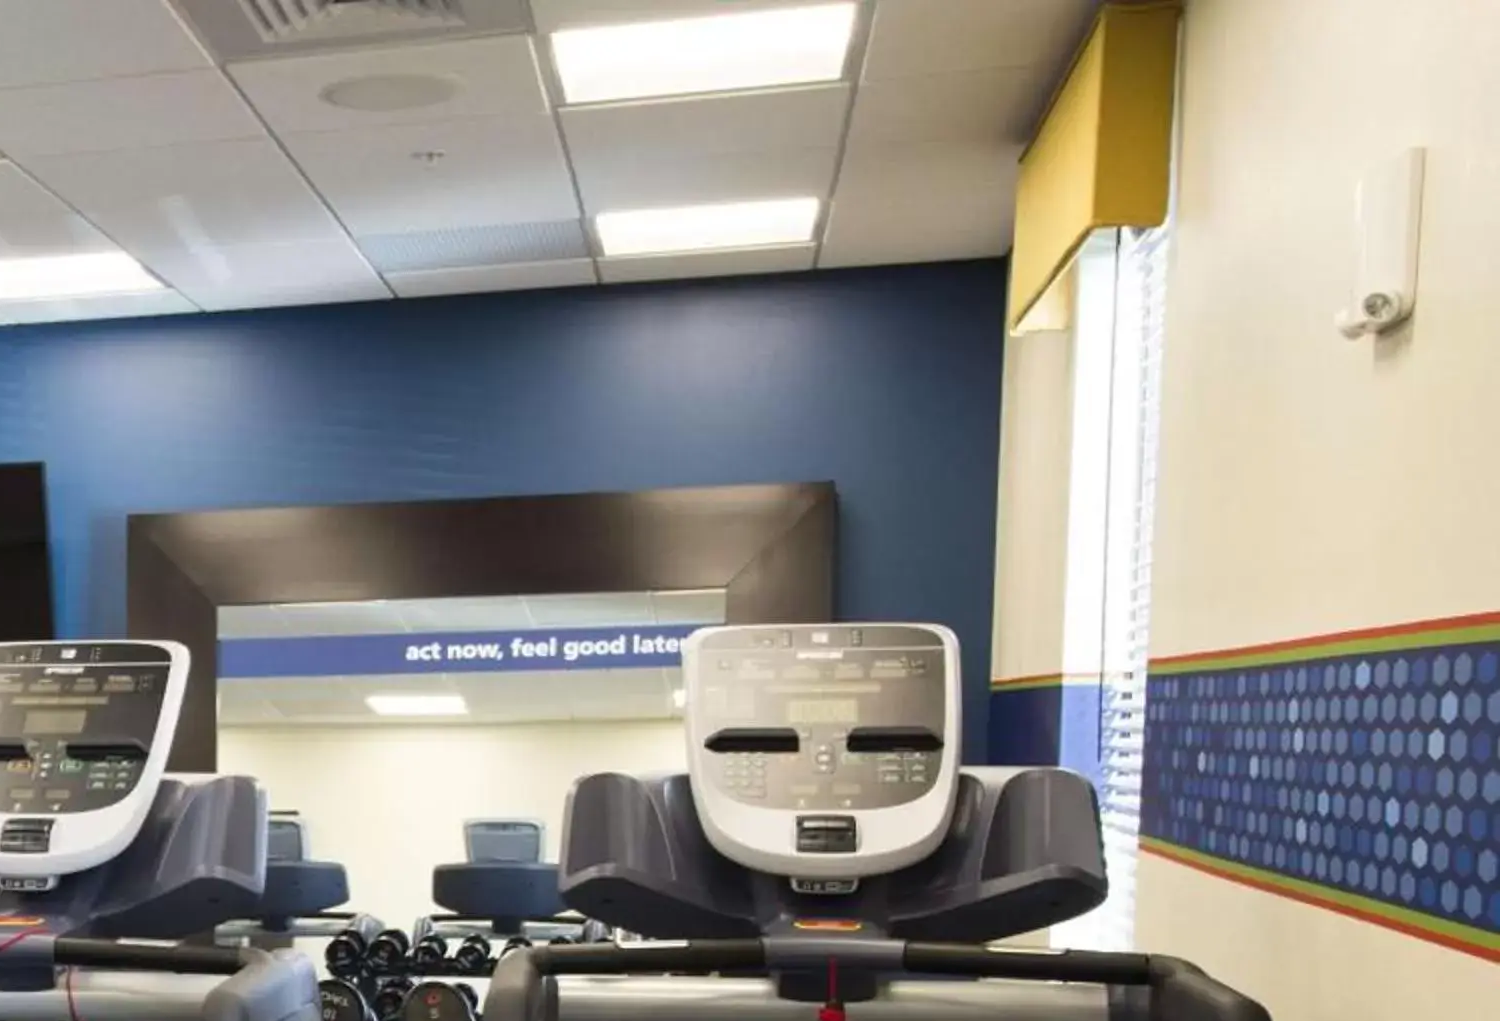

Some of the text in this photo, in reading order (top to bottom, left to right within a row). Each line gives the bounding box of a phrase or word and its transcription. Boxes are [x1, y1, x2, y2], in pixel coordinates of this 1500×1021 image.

[405, 641, 441, 661] act
[447, 642, 504, 661] now,
[510, 637, 557, 658] feel
[563, 635, 626, 661] good
